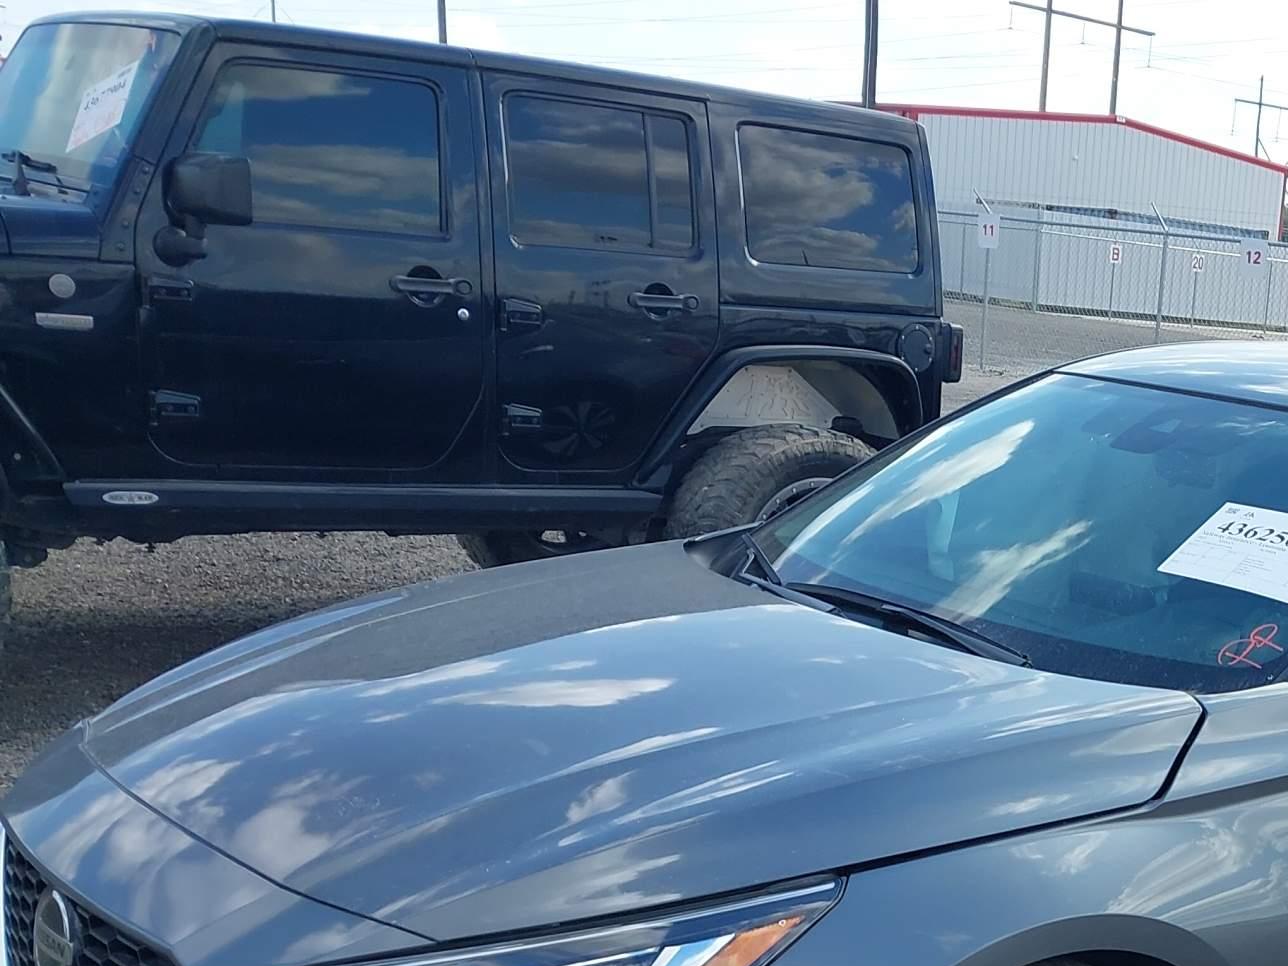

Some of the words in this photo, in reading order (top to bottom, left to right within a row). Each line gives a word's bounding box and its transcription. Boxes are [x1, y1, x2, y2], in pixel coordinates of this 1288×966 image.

[982, 223, 994, 237] 11
[1111, 247, 1121, 261] B
[1246, 250, 1262, 265] 12
[1192, 256, 1204, 271] 20
